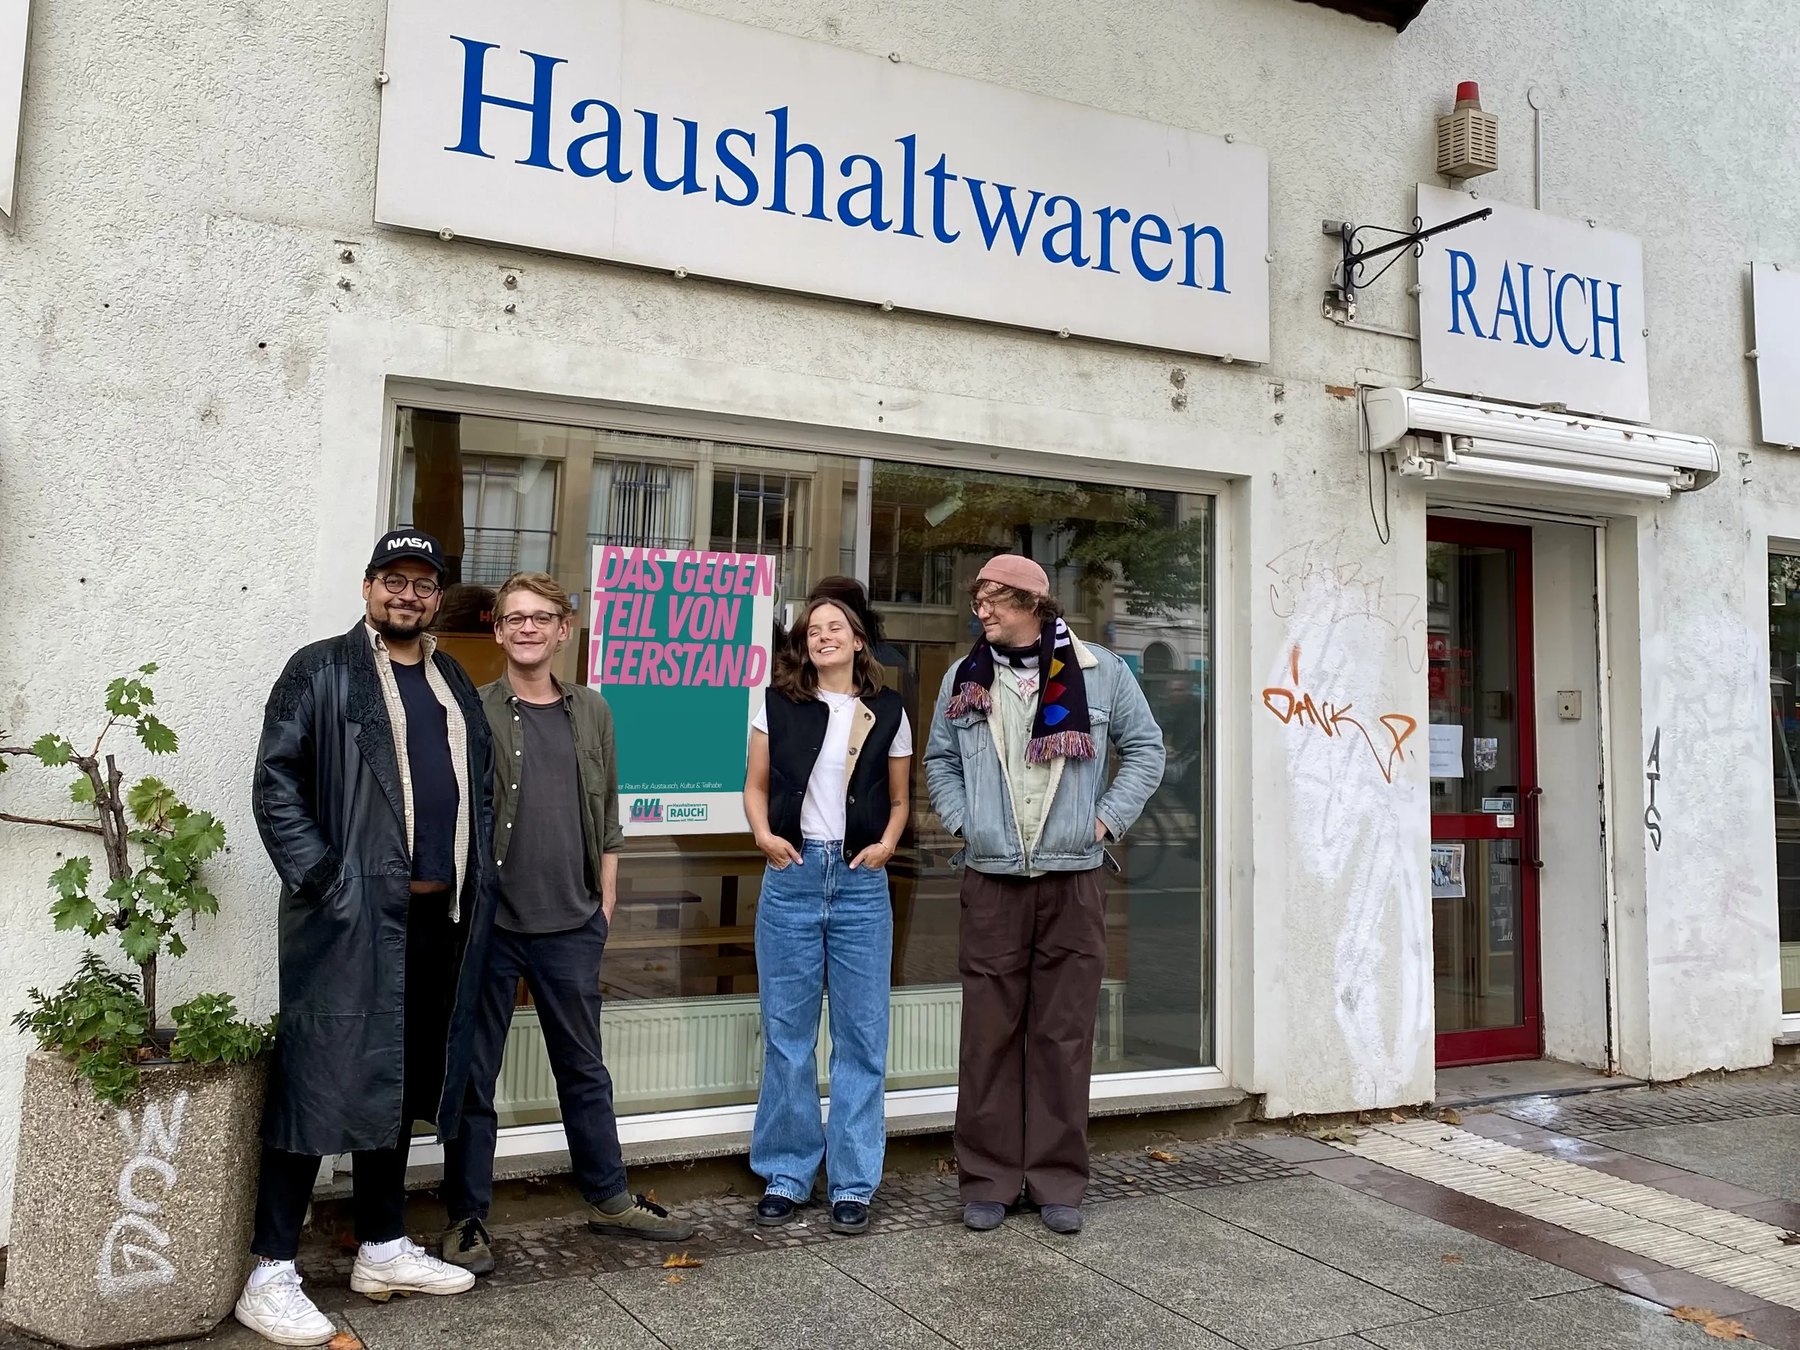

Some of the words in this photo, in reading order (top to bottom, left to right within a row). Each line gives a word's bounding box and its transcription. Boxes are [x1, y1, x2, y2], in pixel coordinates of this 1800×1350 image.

[443, 35, 1231, 294] Haushaltwaren
[1445, 249, 1626, 364] RAUCH
[388, 537, 433, 553] NASA
[597, 545, 665, 592] DAS
[672, 551, 775, 597] GEGEN
[593, 591, 657, 638] TEIL
[668, 597, 742, 641] VON
[590, 640, 768, 688] LEERSTAND
[632, 798, 661, 817] GVL
[670, 808, 704, 817] RAUCH
